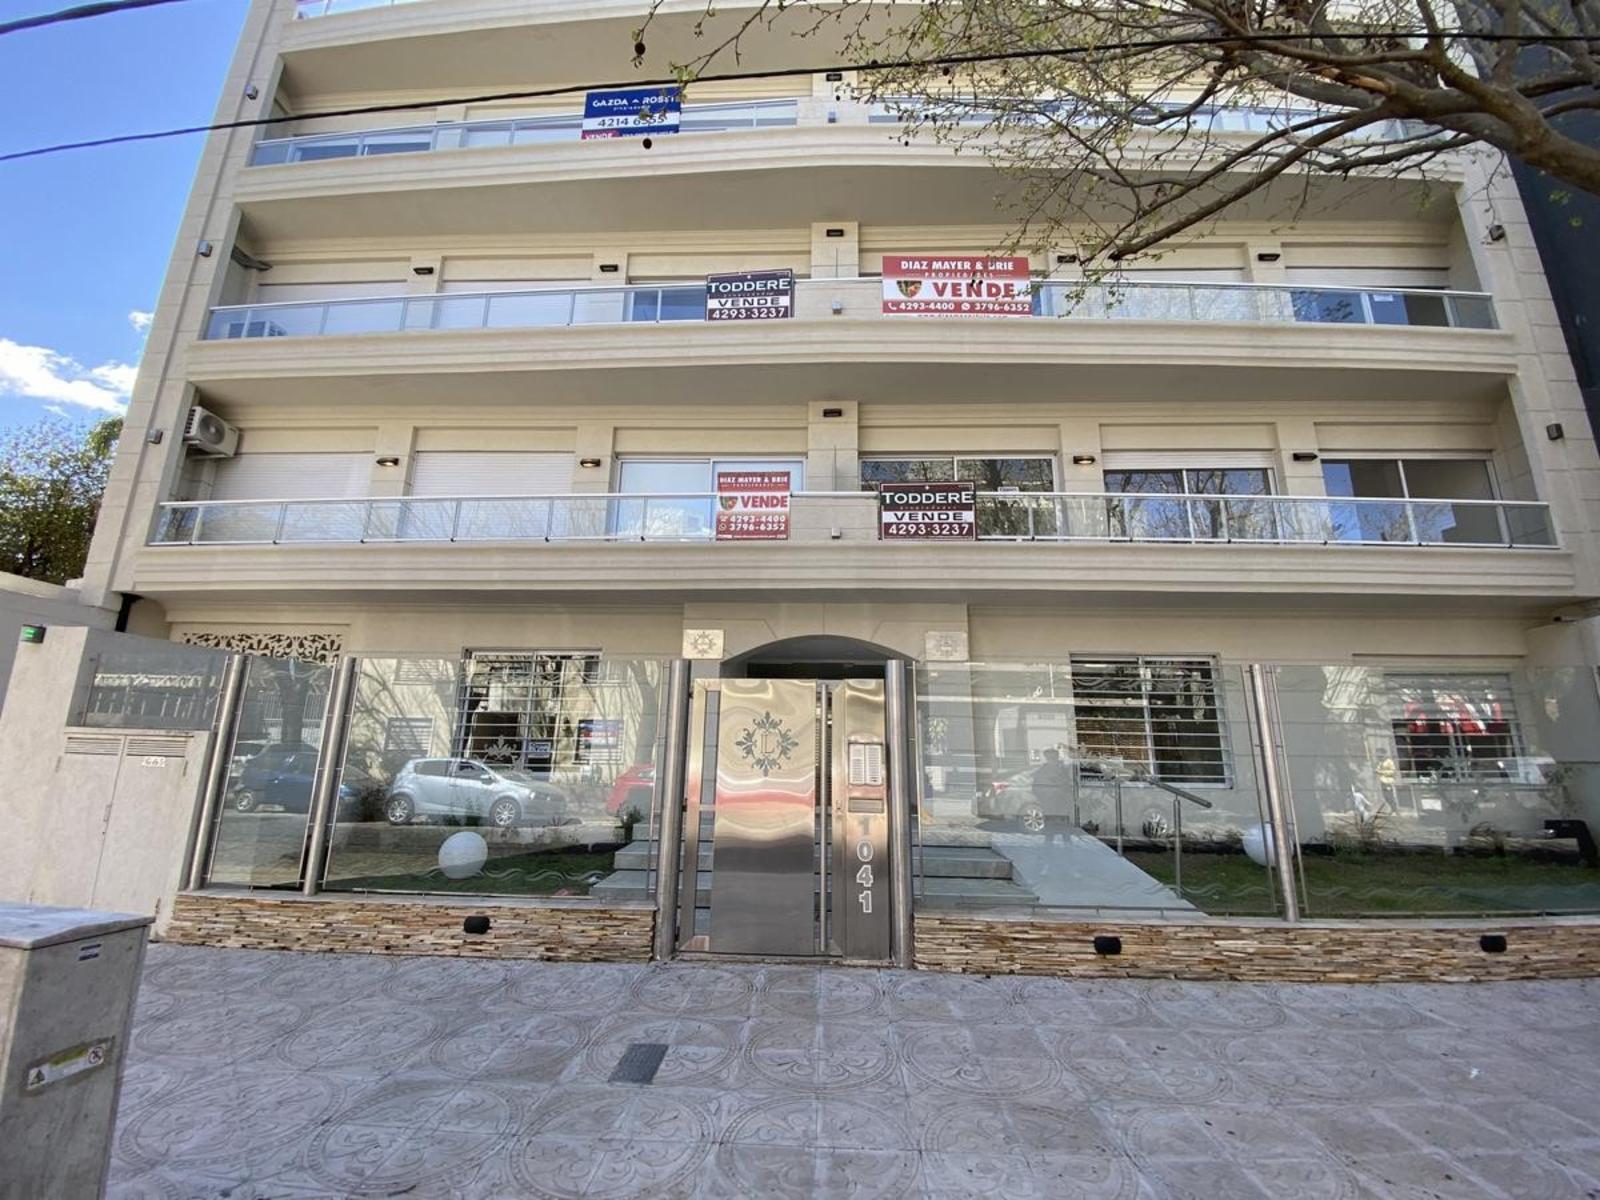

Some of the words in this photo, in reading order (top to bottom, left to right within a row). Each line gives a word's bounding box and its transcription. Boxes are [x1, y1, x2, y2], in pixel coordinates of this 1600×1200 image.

[592, 98, 629, 107] GAZDA
[597, 117, 629, 127] 4214
[901, 261, 928, 270] DIAZ
[932, 261, 971, 270] MAYER
[975, 261, 984, 270] &
[707, 278, 791, 293] TODDERE
[932, 282, 1015, 298] VENDE
[718, 297, 781, 307] VENDE
[899, 302, 955, 310] 4293-4400
[975, 303, 1030, 311] 3796-6352
[740, 495, 788, 508] VENDE
[881, 491, 975, 504] TODDERE
[894, 512, 964, 521] VENDE
[856, 815, 874, 913] 1041
